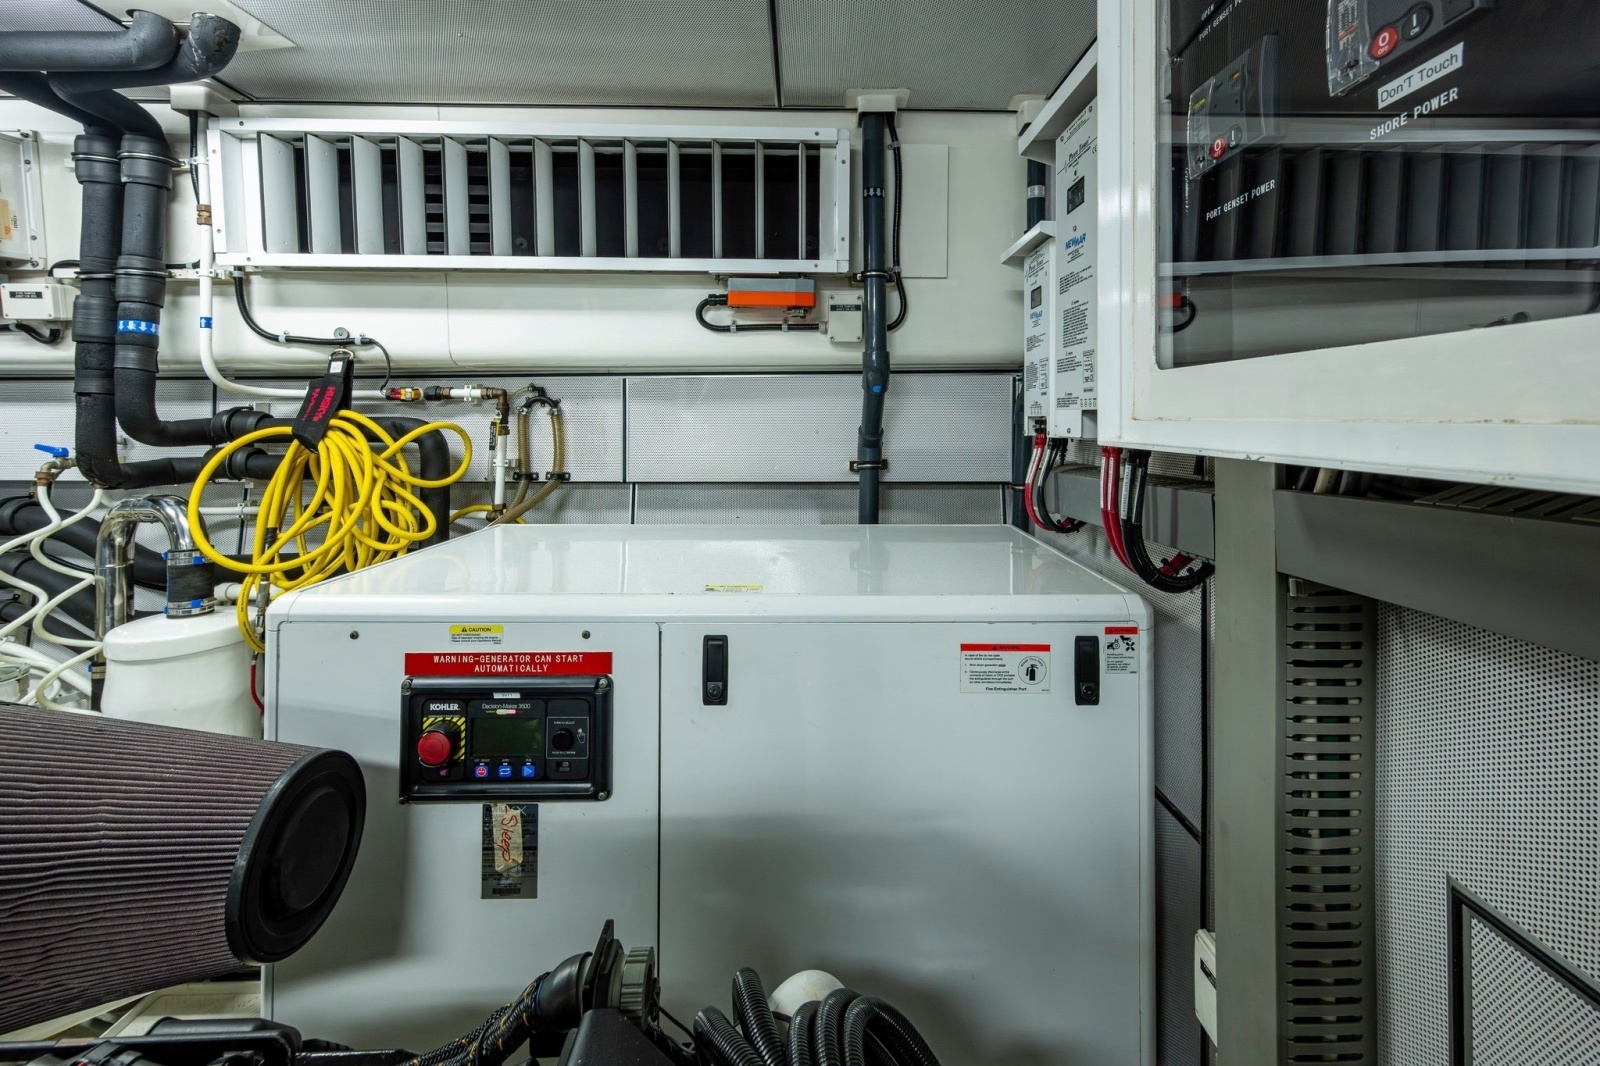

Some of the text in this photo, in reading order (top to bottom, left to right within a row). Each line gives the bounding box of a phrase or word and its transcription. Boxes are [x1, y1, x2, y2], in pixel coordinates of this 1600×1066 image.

[1199, 25, 1212, 42] PORT
[1410, 27, 1420, 36] ON
[1378, 46, 1388, 55] OFF
[1380, 54, 1458, 102] Don'T Touch
[1370, 88, 1459, 140] SHORE POWER
[1206, 179, 1276, 222] PORT GENSET POWER
[433, 654, 584, 663] WARNING-GENERATOR CAN START
[474, 664, 548, 673] AUTOMATICALLY
